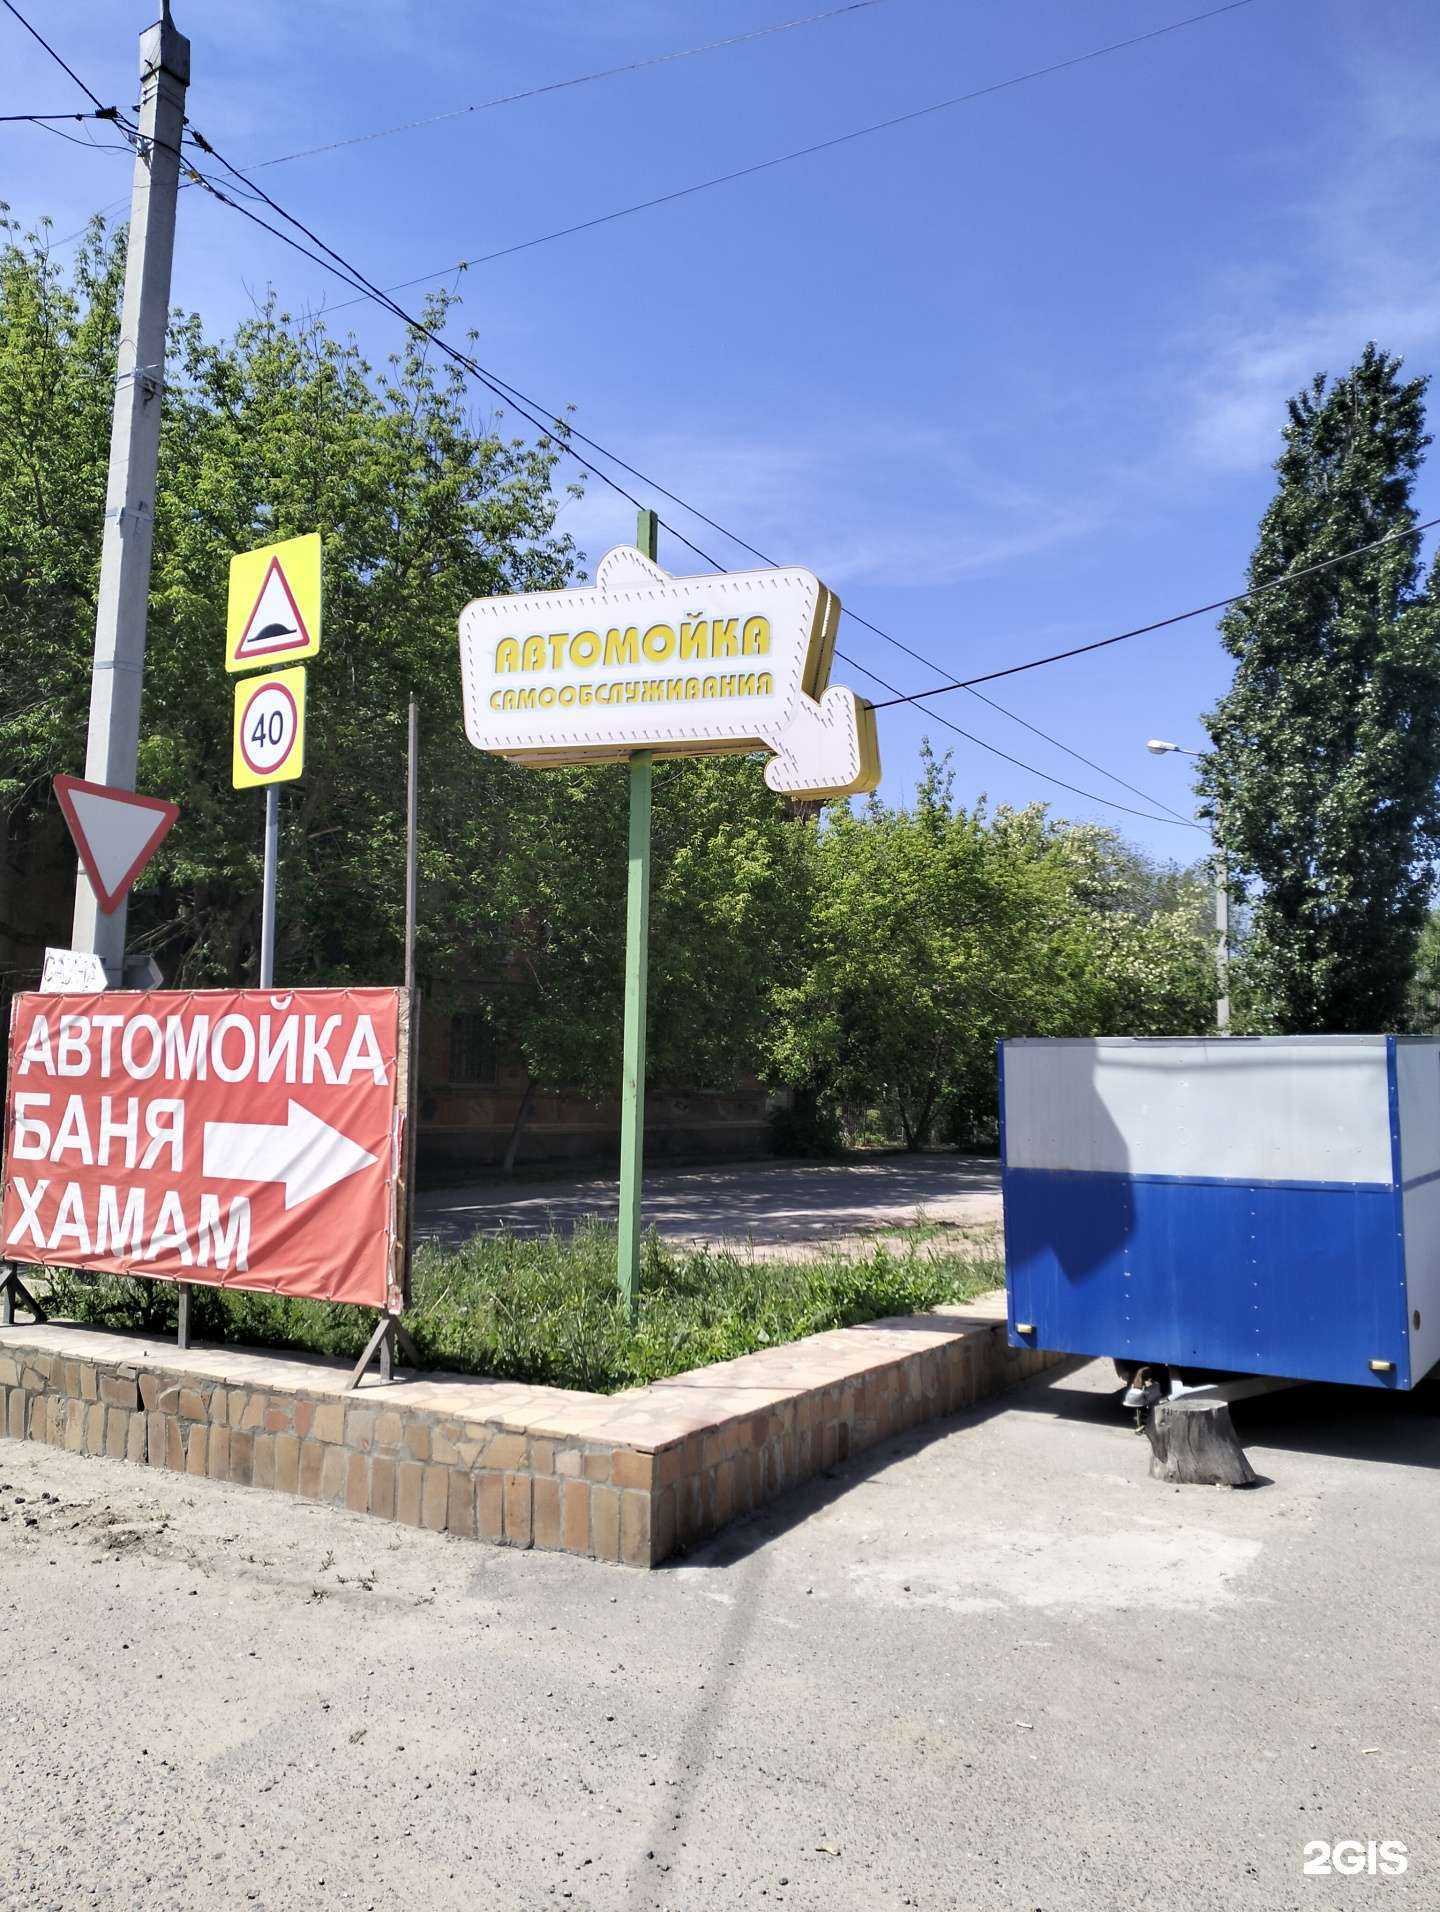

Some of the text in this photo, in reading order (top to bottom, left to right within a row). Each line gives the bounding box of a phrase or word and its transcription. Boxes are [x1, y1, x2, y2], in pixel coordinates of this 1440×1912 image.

[494, 611, 771, 674] АВТОМОЙКА
[489, 671, 774, 711] САМООБСЛУЖИВАНИЯ
[251, 710, 284, 748] 40
[17, 995, 389, 1086] АВТОМОЙКА
[12, 1092, 185, 1173] БАНЯ
[7, 1176, 252, 1272] ХАМАМ
